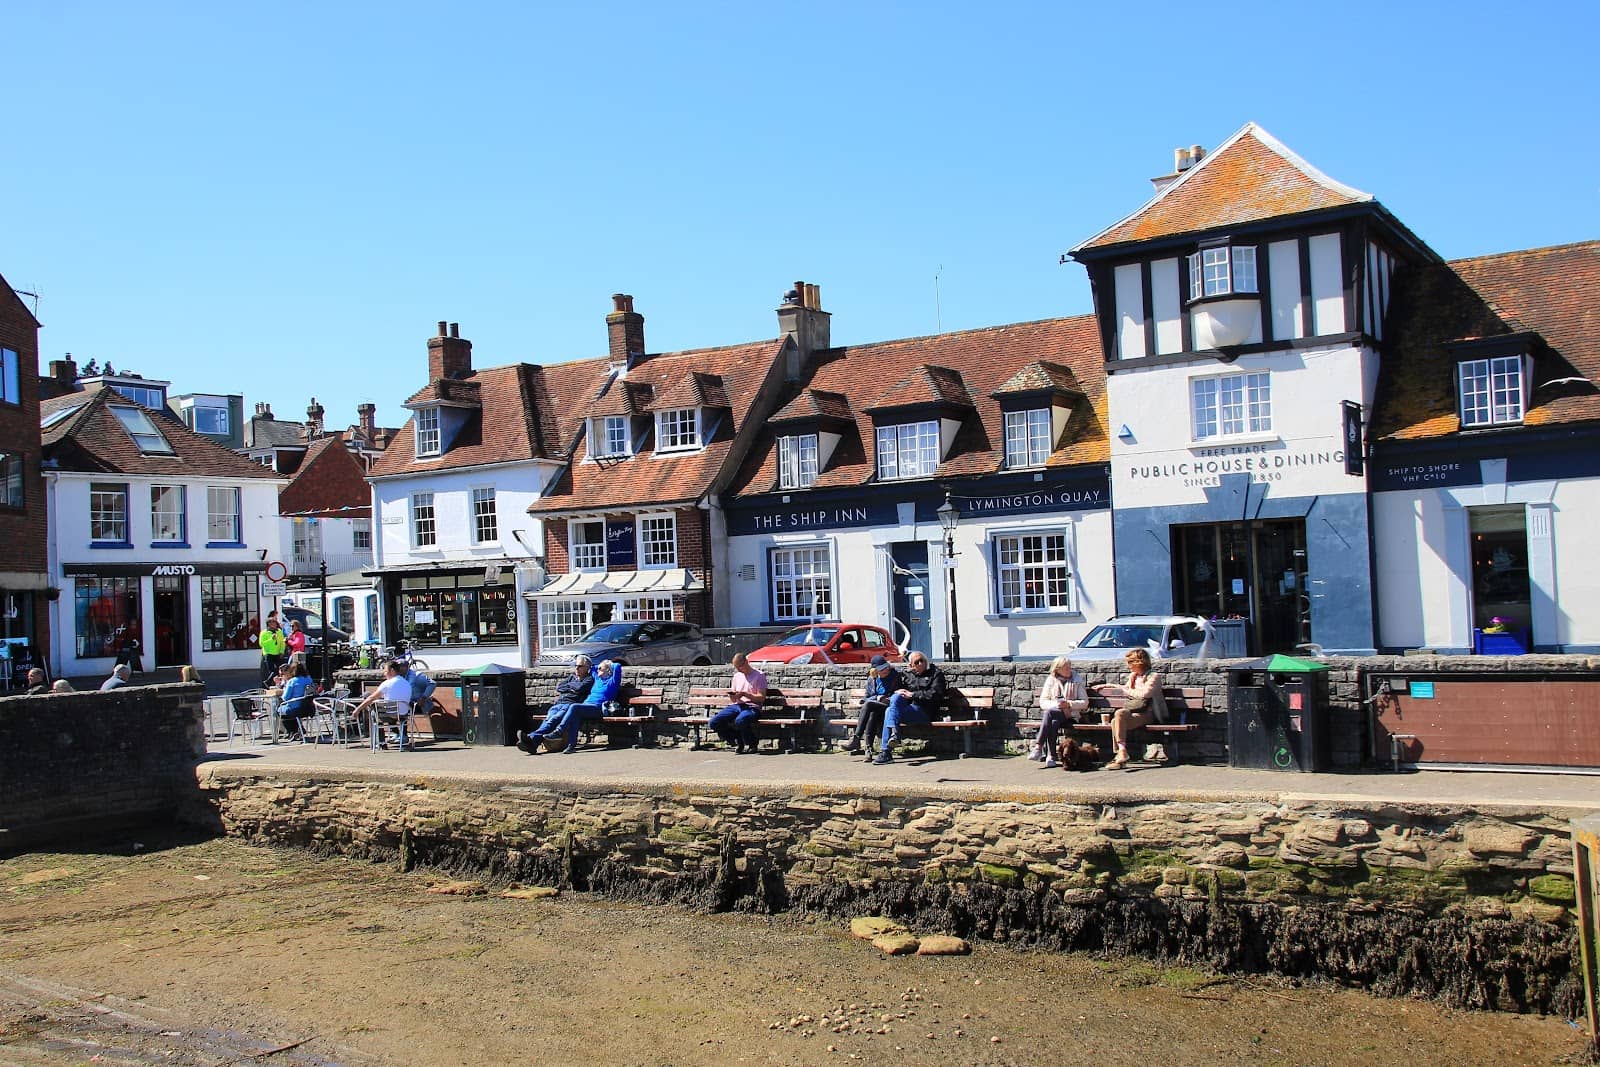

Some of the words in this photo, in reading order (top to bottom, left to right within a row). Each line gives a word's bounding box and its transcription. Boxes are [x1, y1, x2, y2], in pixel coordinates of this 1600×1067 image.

[1200, 448, 1226, 457] FREE
[1231, 445, 1266, 454] TRADE
[1131, 462, 1188, 479] PUBLIC
[1194, 458, 1253, 473] HOUSE
[1258, 457, 1269, 469] &
[1274, 450, 1345, 467] DINING
[1388, 467, 1409, 475] SHIP
[1428, 463, 1460, 472] SHORE
[1183, 476, 1218, 487] SINCE
[969, 494, 1054, 511] LYMINGTON
[1060, 490, 1100, 503] QUAY
[754, 514, 782, 529] THE
[791, 511, 826, 526] SHIP
[835, 507, 867, 522] INN
[152, 565, 195, 576] MUSTO
